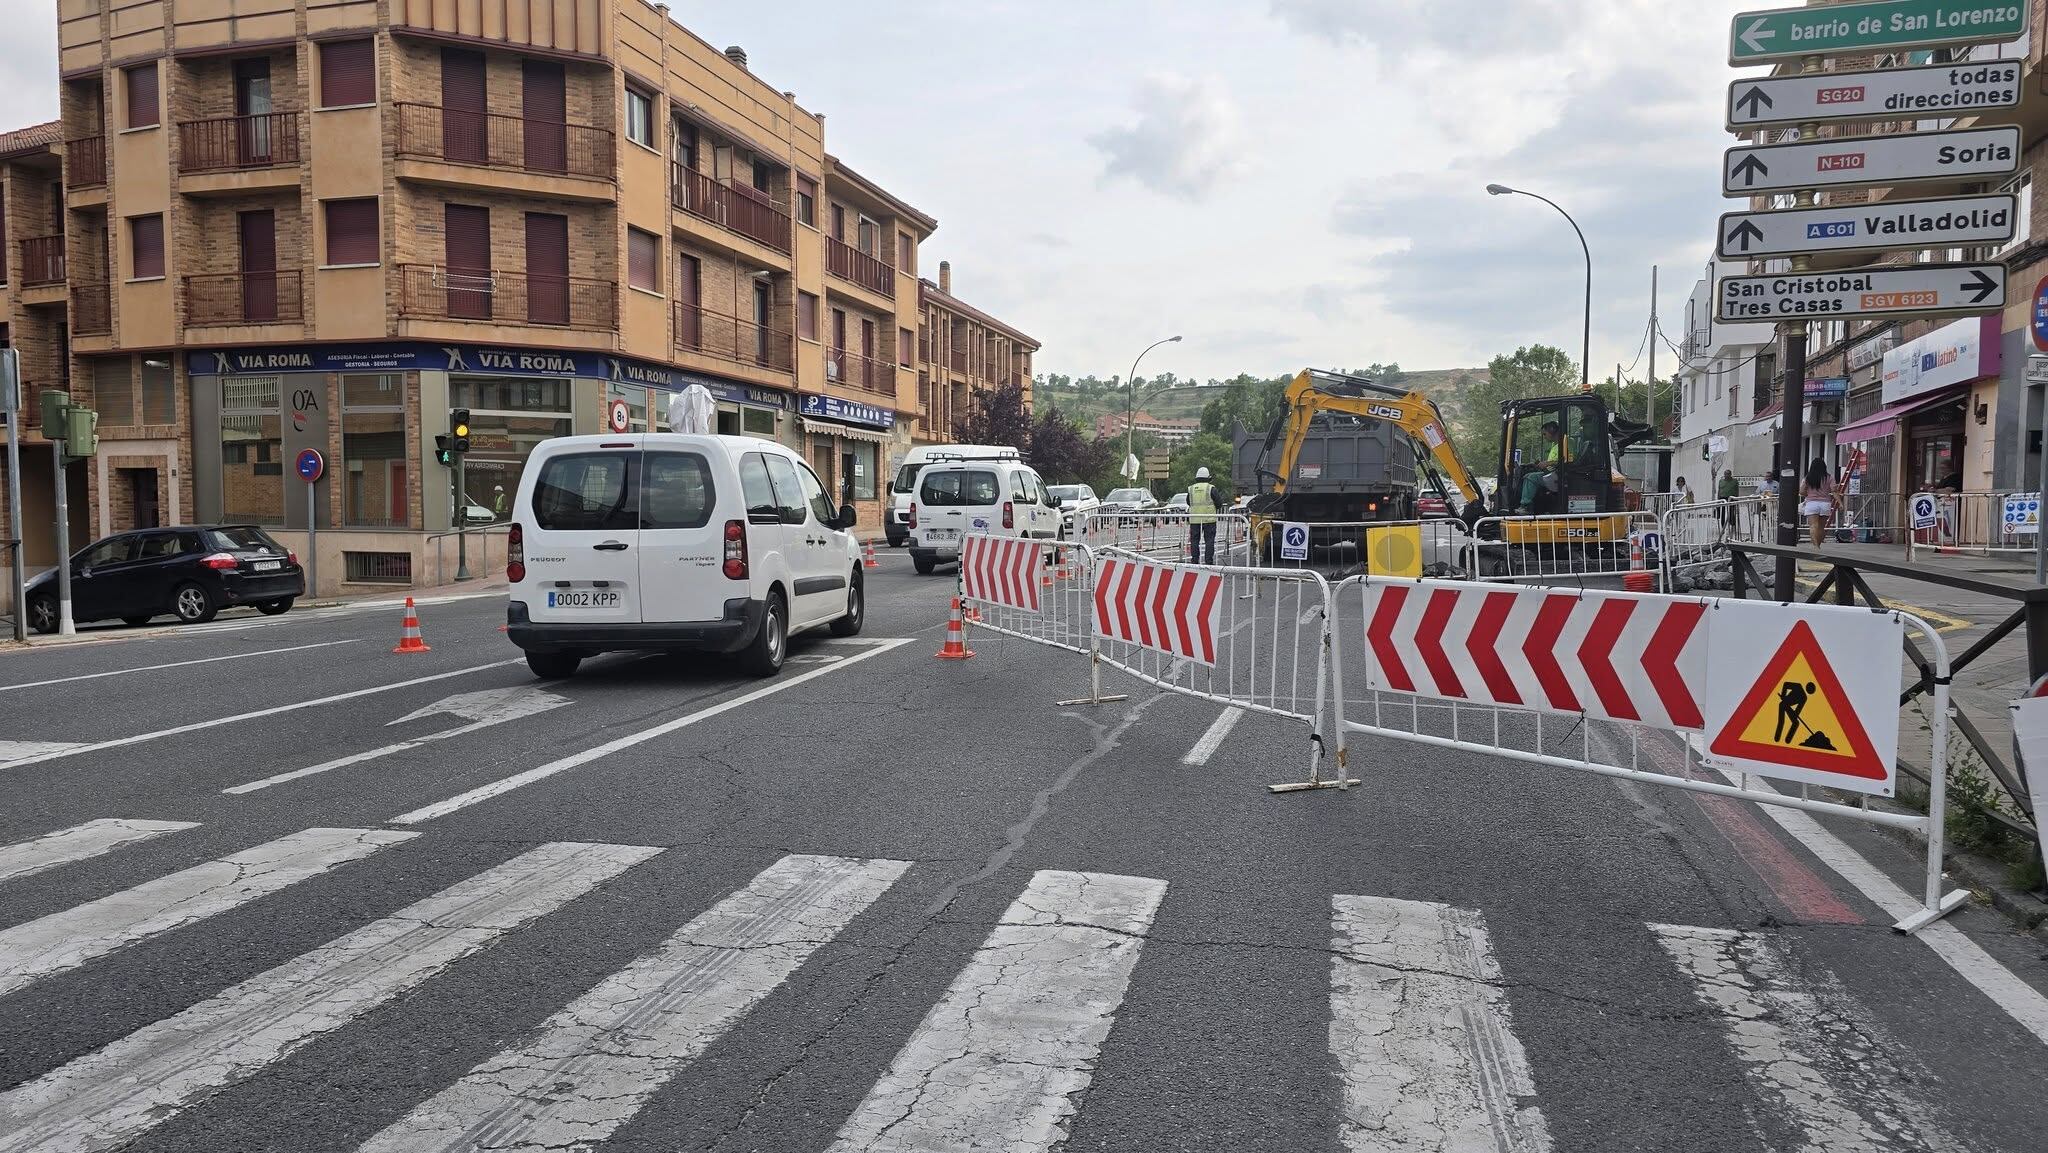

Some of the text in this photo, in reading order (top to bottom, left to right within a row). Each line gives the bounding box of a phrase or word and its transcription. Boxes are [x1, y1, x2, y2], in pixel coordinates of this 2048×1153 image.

[1791, 6, 2018, 41] barrio de San Lorenzo
[1949, 67, 2015, 86] todas
[1820, 88, 1861, 102] SG20
[1884, 87, 2014, 110] direcciones
[1821, 155, 1861, 169] N-110
[1937, 142, 2011, 165] Soria
[1810, 223, 1855, 237] A 601
[1864, 208, 2007, 236] Valladolid
[1726, 275, 1872, 298] San Cristobal
[1725, 297, 1843, 317] Tres Casas
[1864, 292, 1934, 307] SGV 6123
[239, 353, 312, 368] VIA ROMA
[478, 353, 576, 371] VIA ROMA
[627, 366, 672, 385] VIA ROMA
[749, 389, 782, 405] VIA ROMA
[1369, 405, 1402, 419] JCB
[556, 592, 618, 606] 0002 KPP
